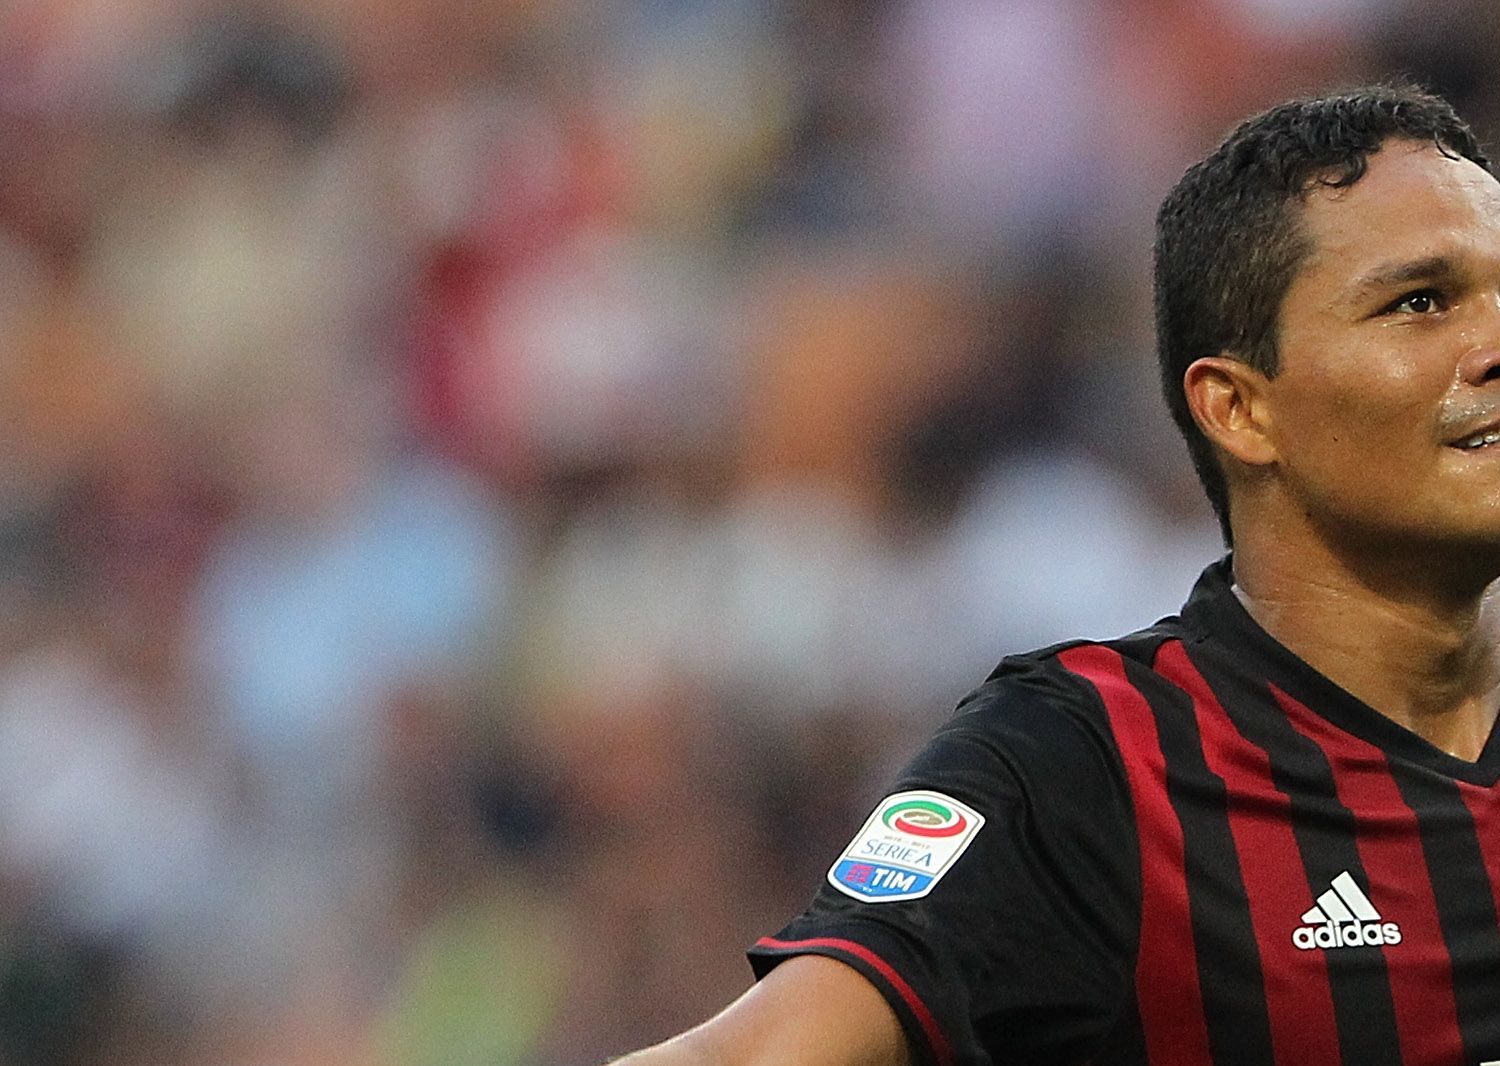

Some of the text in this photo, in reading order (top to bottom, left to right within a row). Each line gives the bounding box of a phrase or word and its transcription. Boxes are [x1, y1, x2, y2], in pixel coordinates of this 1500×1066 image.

[861, 838, 933, 867] SERIE A
[872, 867, 917, 892] TIM
[1292, 918, 1402, 950] adidas
